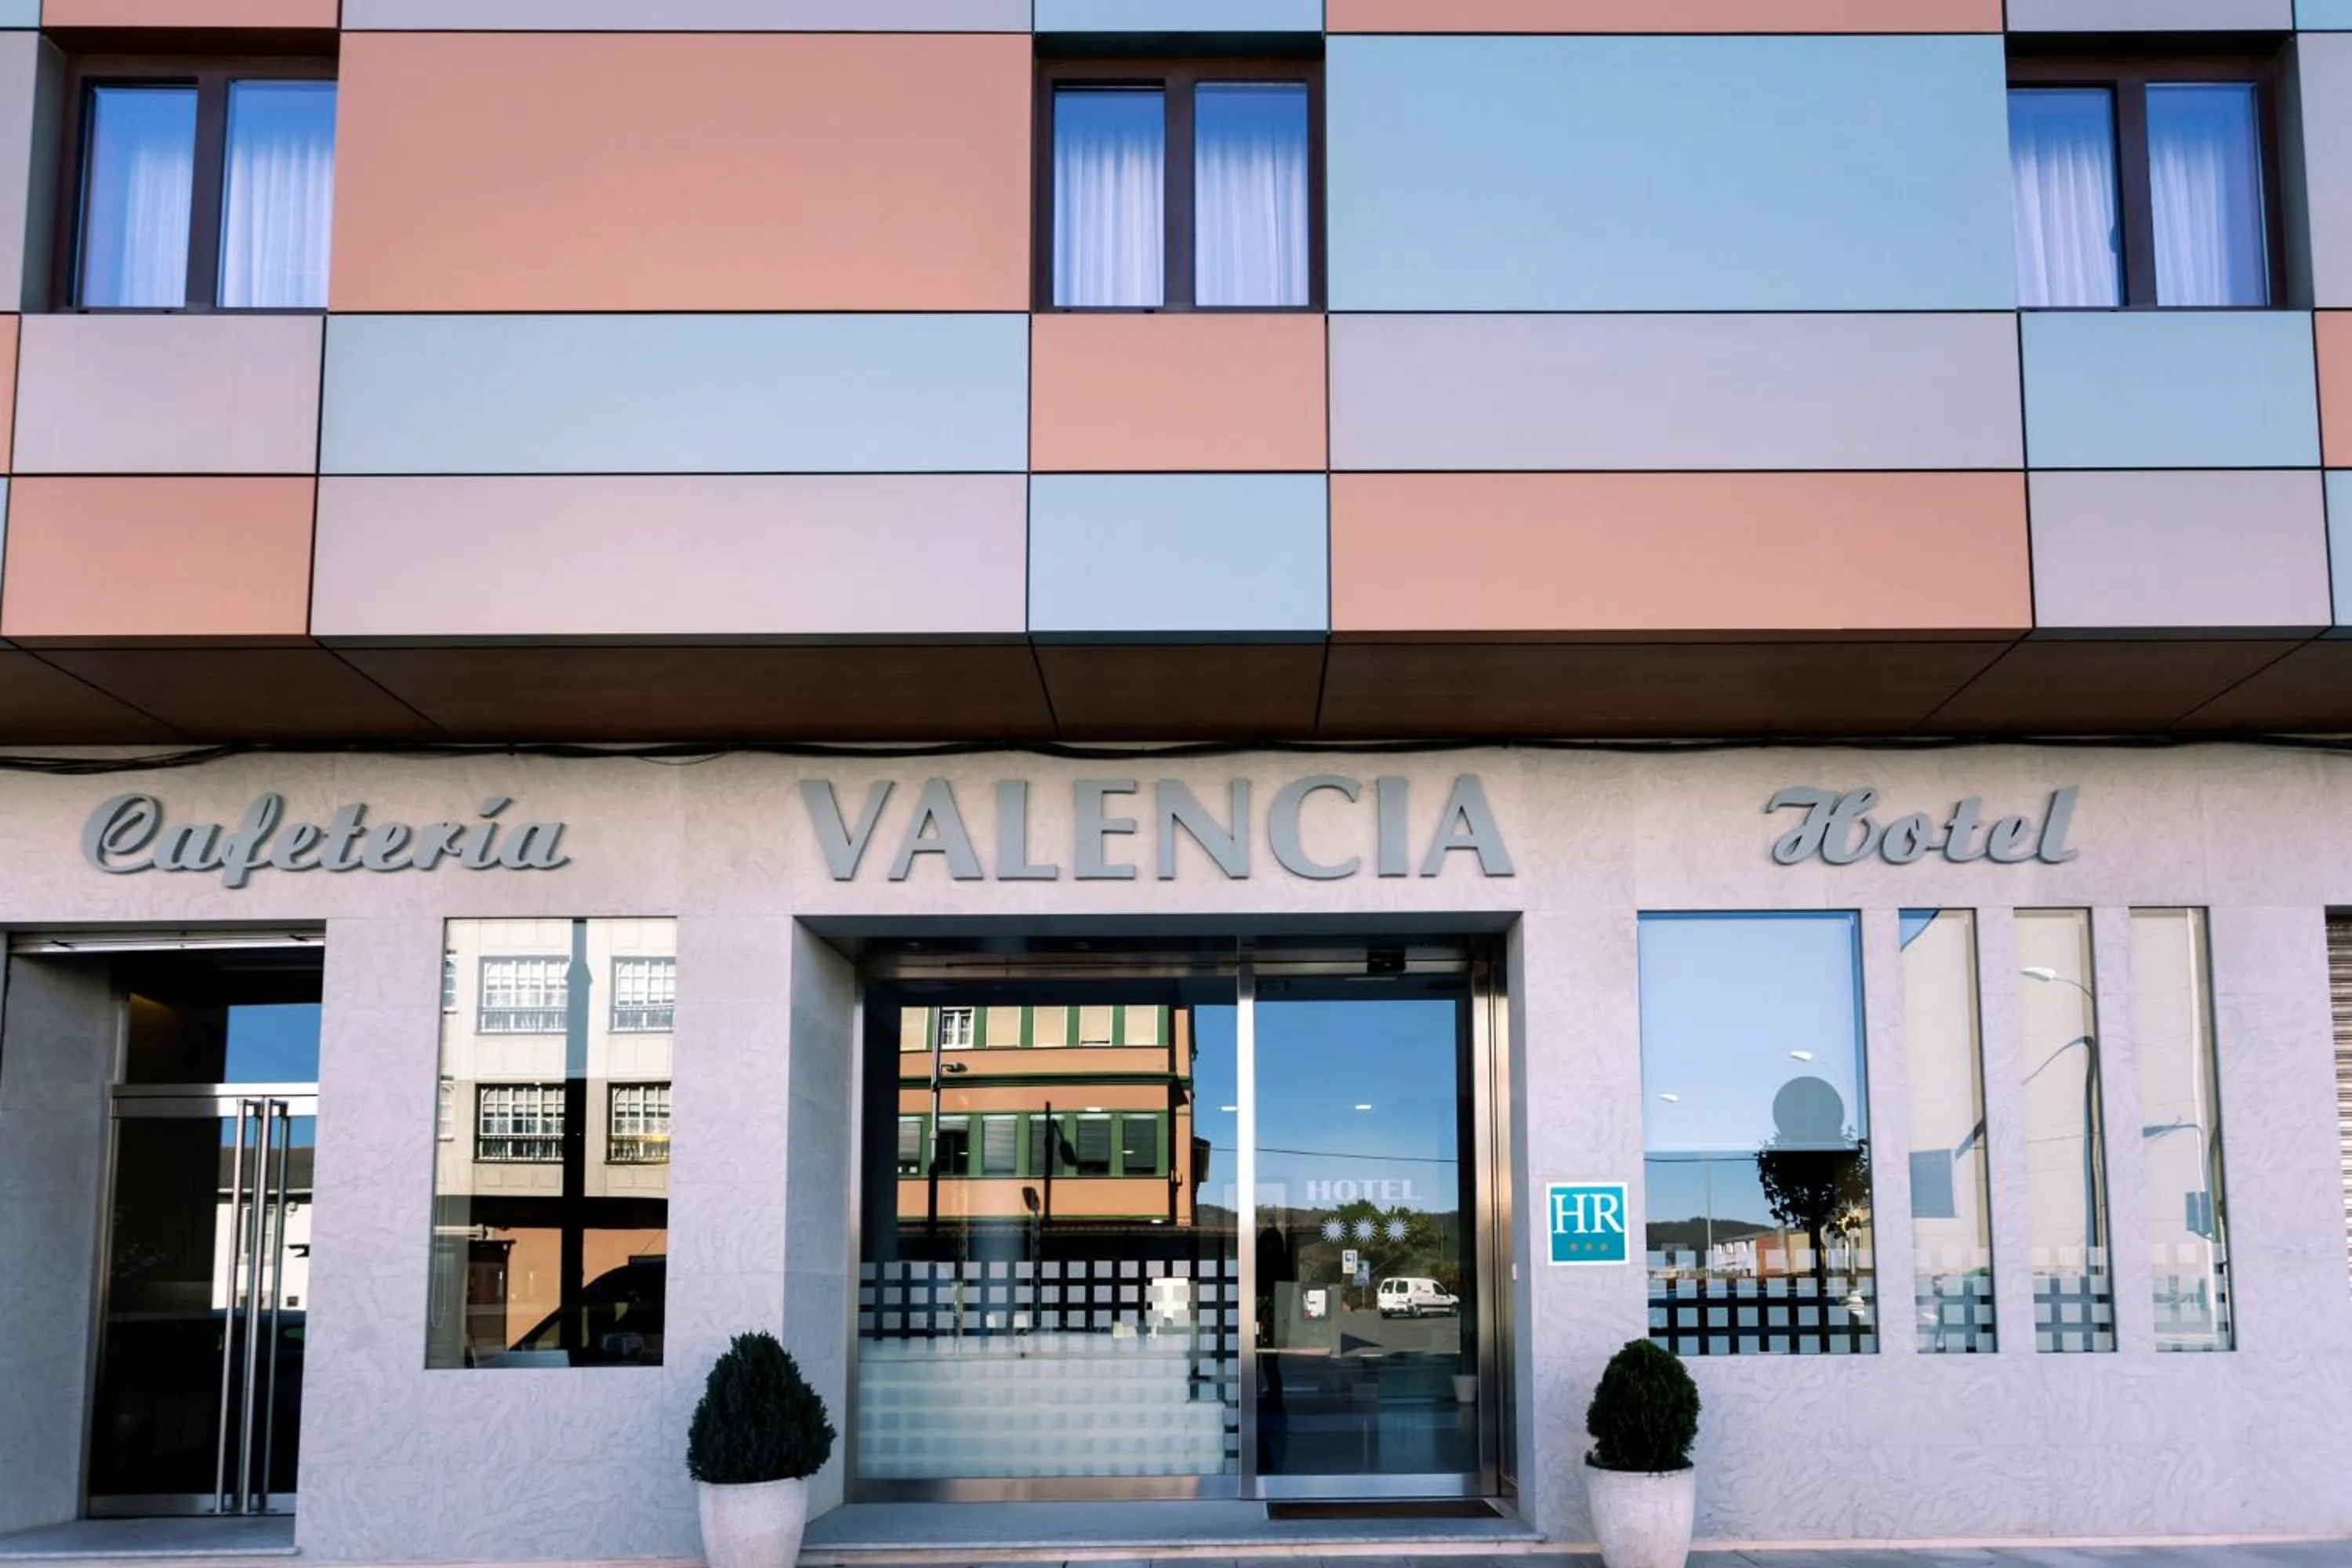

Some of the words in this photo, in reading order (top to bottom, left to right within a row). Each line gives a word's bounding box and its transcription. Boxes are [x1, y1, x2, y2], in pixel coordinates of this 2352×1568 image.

[82, 792, 572, 888] Cafetería
[795, 772, 1515, 881] VALENCIA
[1765, 785, 2080, 864] Hotel
[1306, 1178, 1423, 1202] HOTEL
[1552, 1192, 1624, 1234] HR
